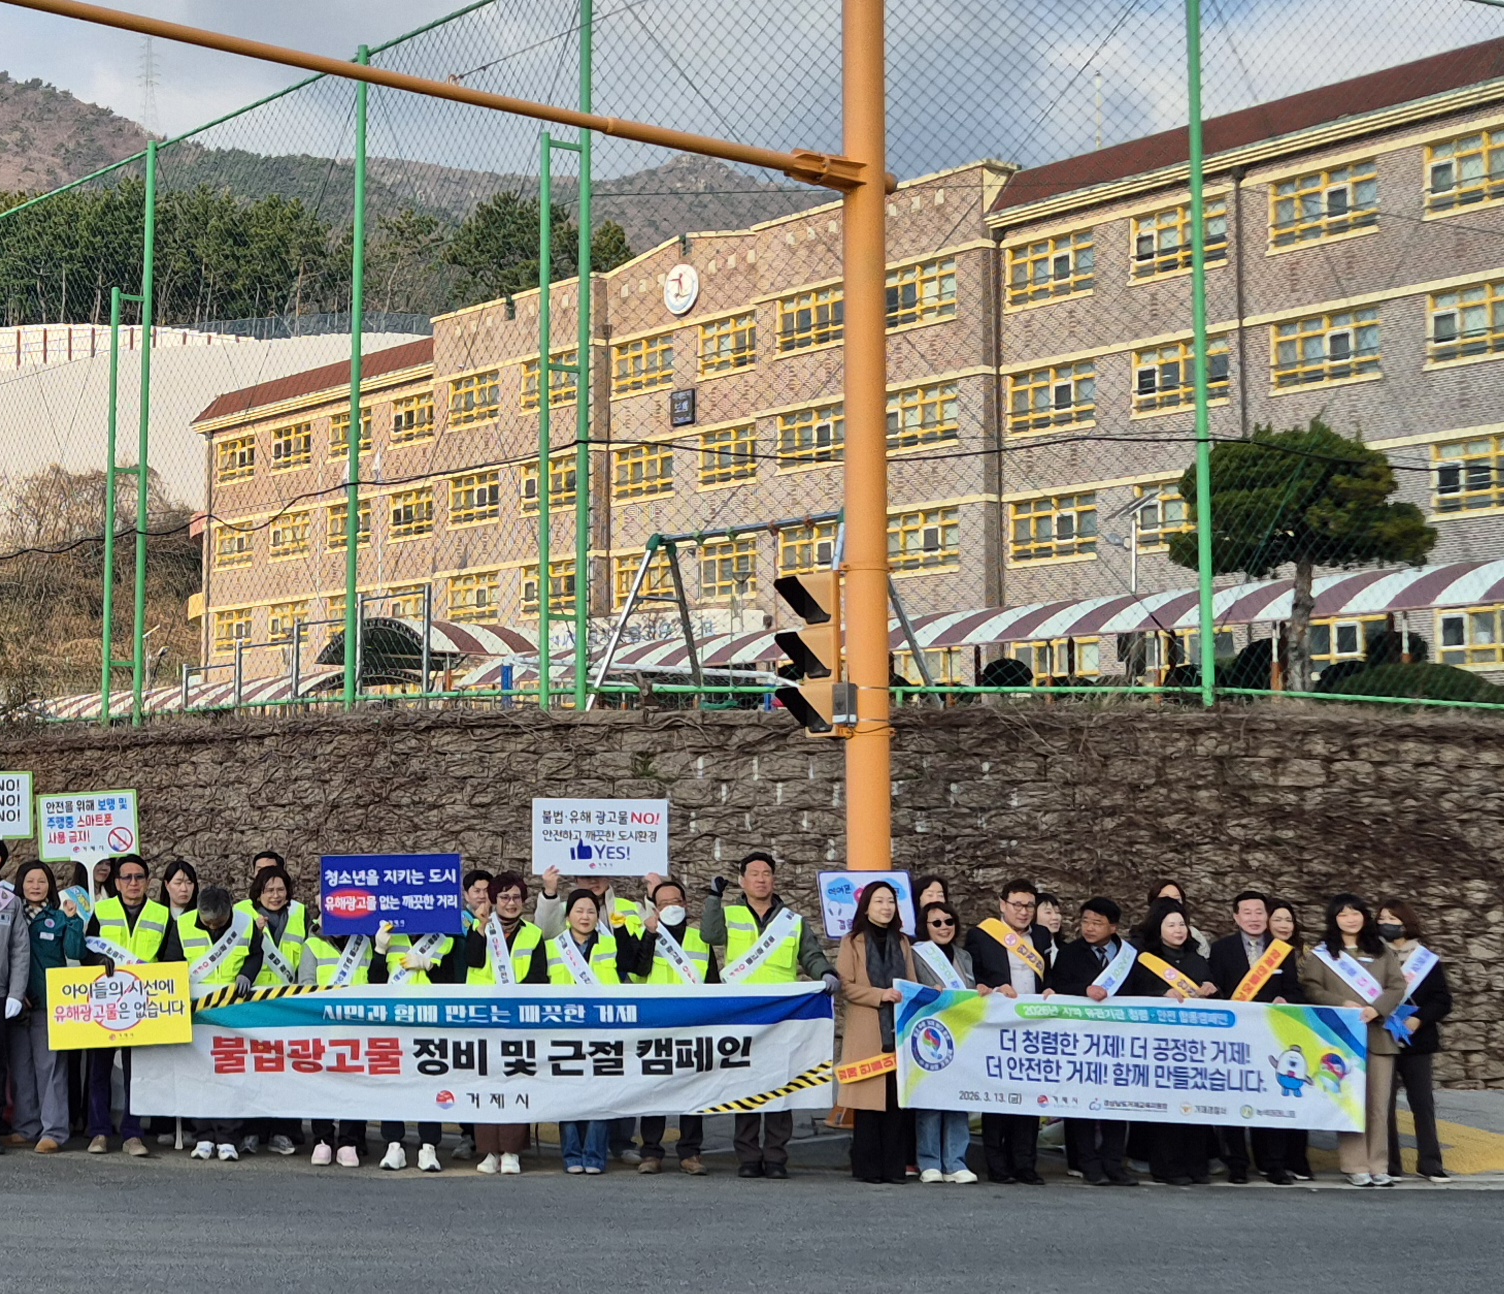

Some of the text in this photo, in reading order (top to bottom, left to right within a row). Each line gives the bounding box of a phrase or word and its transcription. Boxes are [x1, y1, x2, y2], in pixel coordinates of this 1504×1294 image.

[46, 797, 128, 815] 안전을 위해 보행 및
[47, 813, 113, 829] 주행중 스마트폰
[595, 809, 629, 826] 광고물
[630, 811, 661, 826] NO!
[48, 829, 91, 845] 사용 금지!
[542, 829, 658, 843] 안전하고 깨끗한 도시환경
[594, 844, 631, 861] YES!
[324, 868, 457, 887] 청소년을 지키는 도시
[324, 893, 458, 912] 유해광고물 없는 깨끗한 거리
[61, 978, 175, 999] 아이들의 시선에
[53, 1000, 185, 1023] 유해광고물은 없습니다
[323, 1004, 638, 1024] 시민과 함께 만드는 깨끗한 거제
[1023, 1004, 1059, 1017] 2026년
[210, 1035, 753, 1077] 불법광고물 정비 및 근절 캠페인
[999, 1028, 1251, 1066] 더 청렴한 거제! 더 공정한 거제!
[986, 1055, 1268, 1093] 더 안전한 거제! 함께 만들겠습니다.
[466, 1092, 530, 1110] 거제시
[959, 1090, 1023, 1105] 2026. 3. 13. (금)
